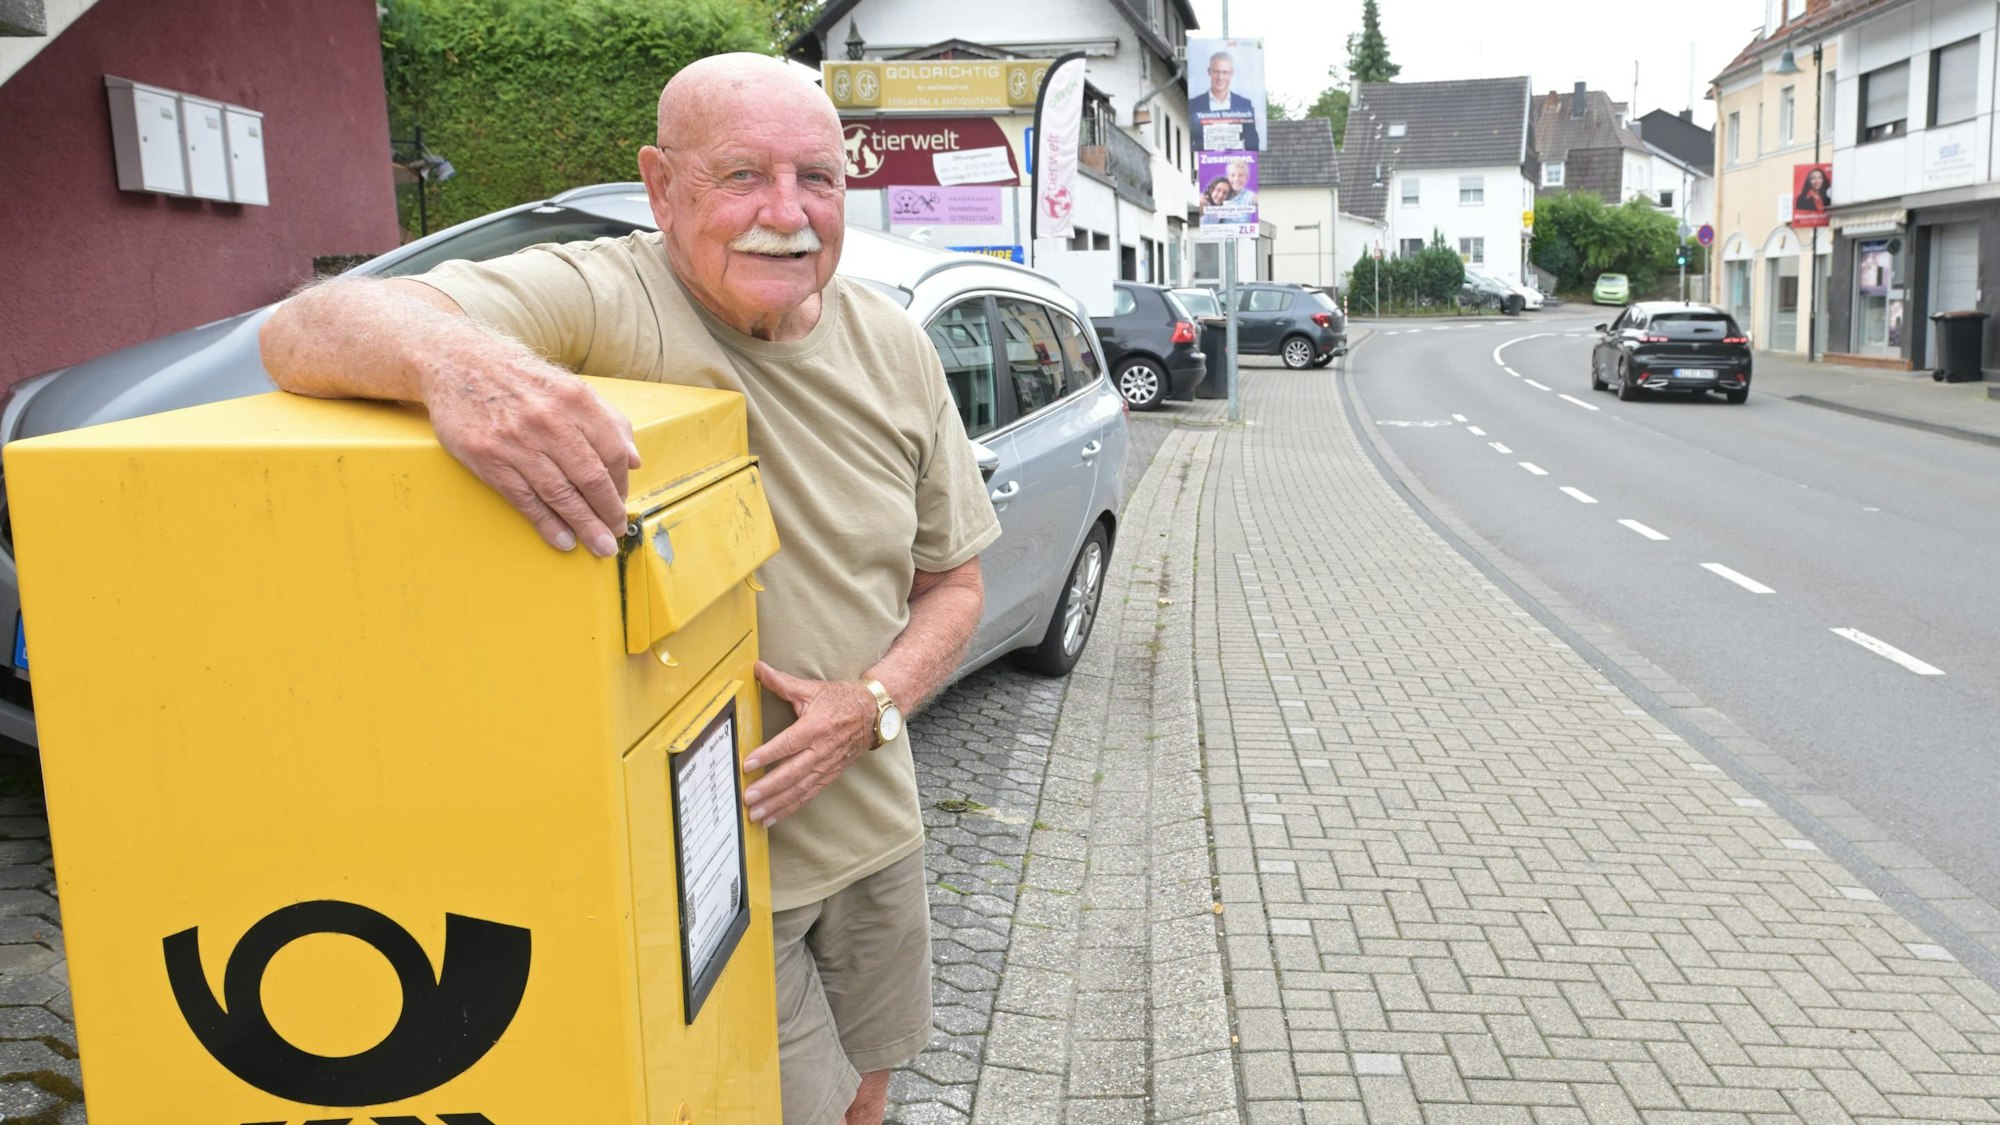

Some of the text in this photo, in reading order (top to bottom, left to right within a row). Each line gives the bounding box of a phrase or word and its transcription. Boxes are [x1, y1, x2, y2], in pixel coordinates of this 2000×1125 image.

[886, 66, 1000, 80] GOLDRICHTIG
[933, 97, 940, 105] &
[941, 95, 1001, 105] ANTIQUITÄTEN
[871, 128, 960, 151] tierwelt
[1200, 154, 1255, 164] Zusammen.
[1239, 225, 1256, 234] ZLR
